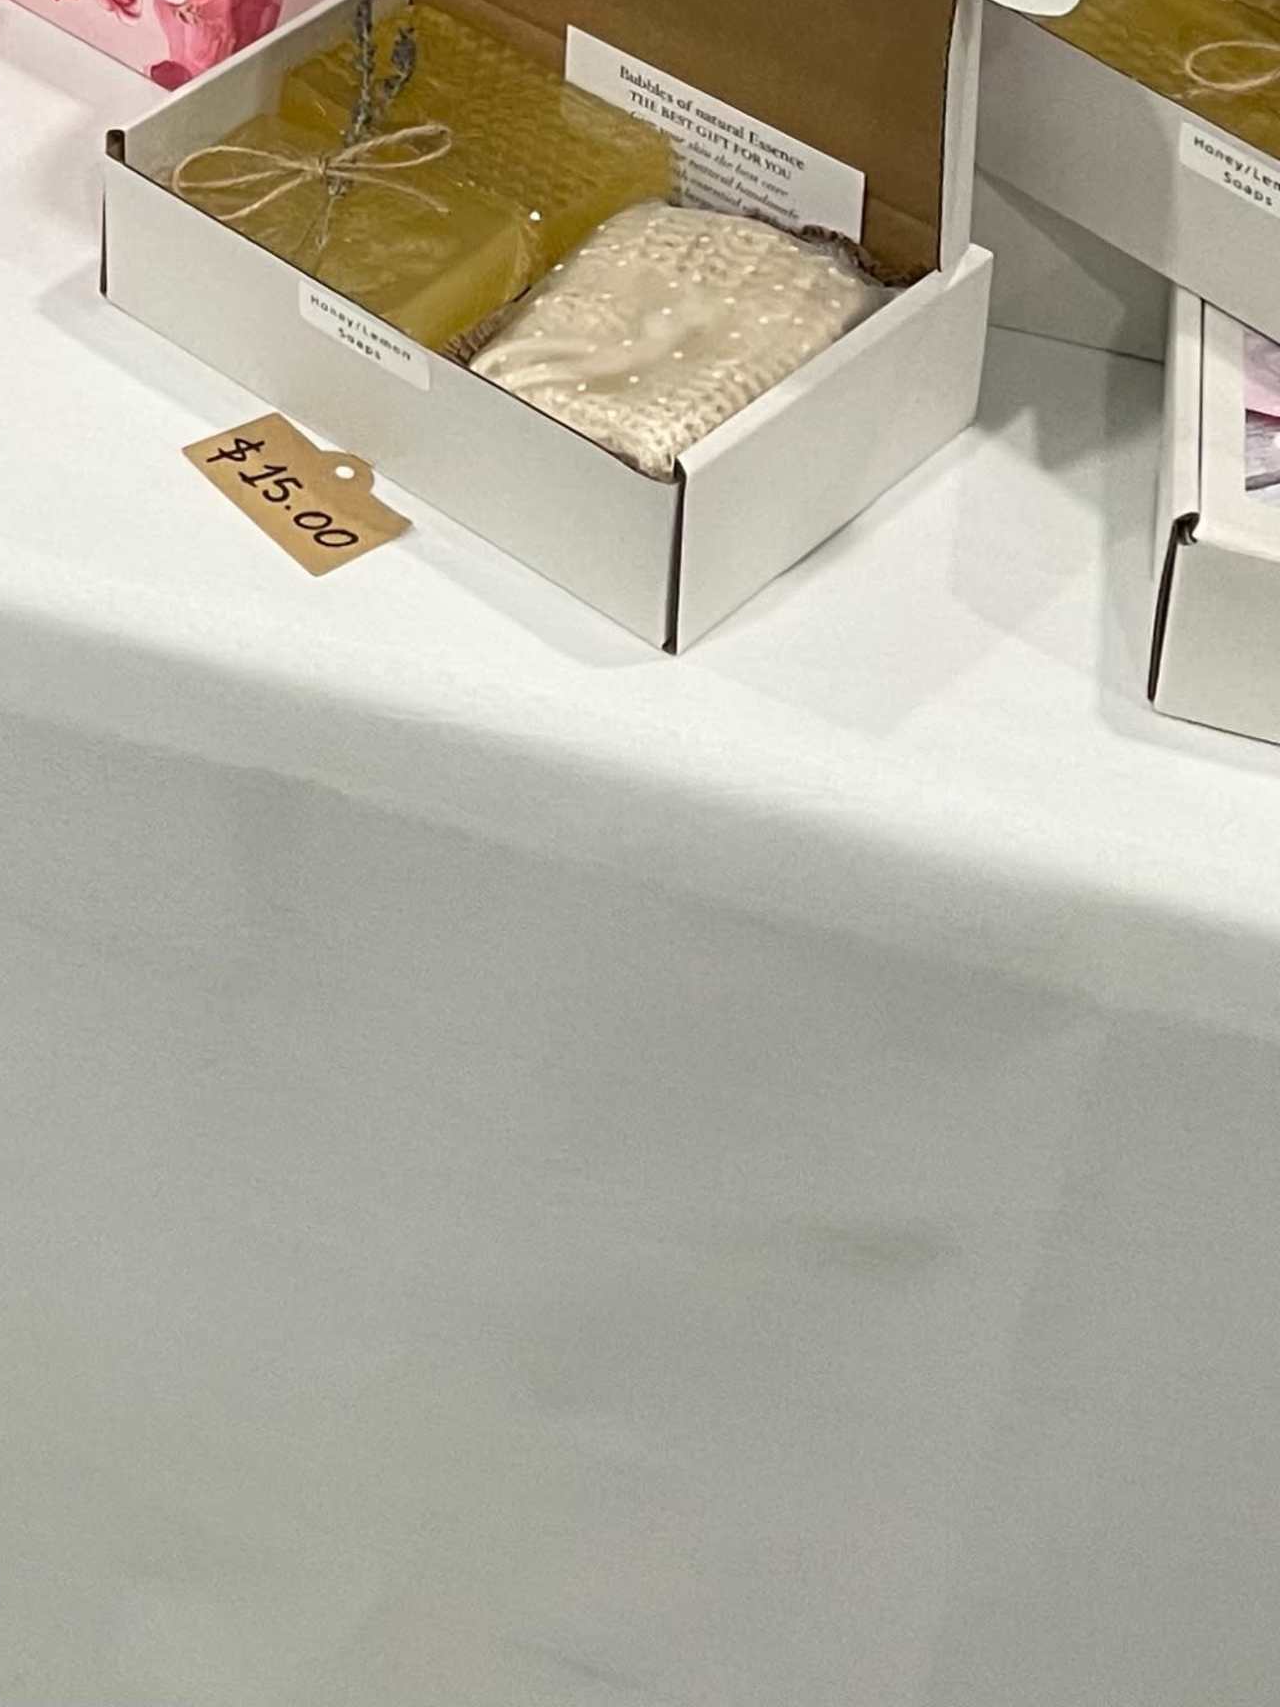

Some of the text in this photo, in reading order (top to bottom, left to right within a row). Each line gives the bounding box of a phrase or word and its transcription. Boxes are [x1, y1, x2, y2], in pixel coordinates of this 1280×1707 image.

[619, 64, 673, 104] Bubbles
[677, 99, 693, 112] of
[695, 108, 745, 140] natural
[749, 130, 805, 171] Essence
[629, 89, 657, 112] THE
[661, 104, 694, 131] BEST
[696, 120, 729, 150] GIFT
[732, 139, 762, 168] FOR
[765, 157, 792, 181] YOU
[1223, 171, 1273, 207] Soaps
[206, 437, 359, 547] $15.00
